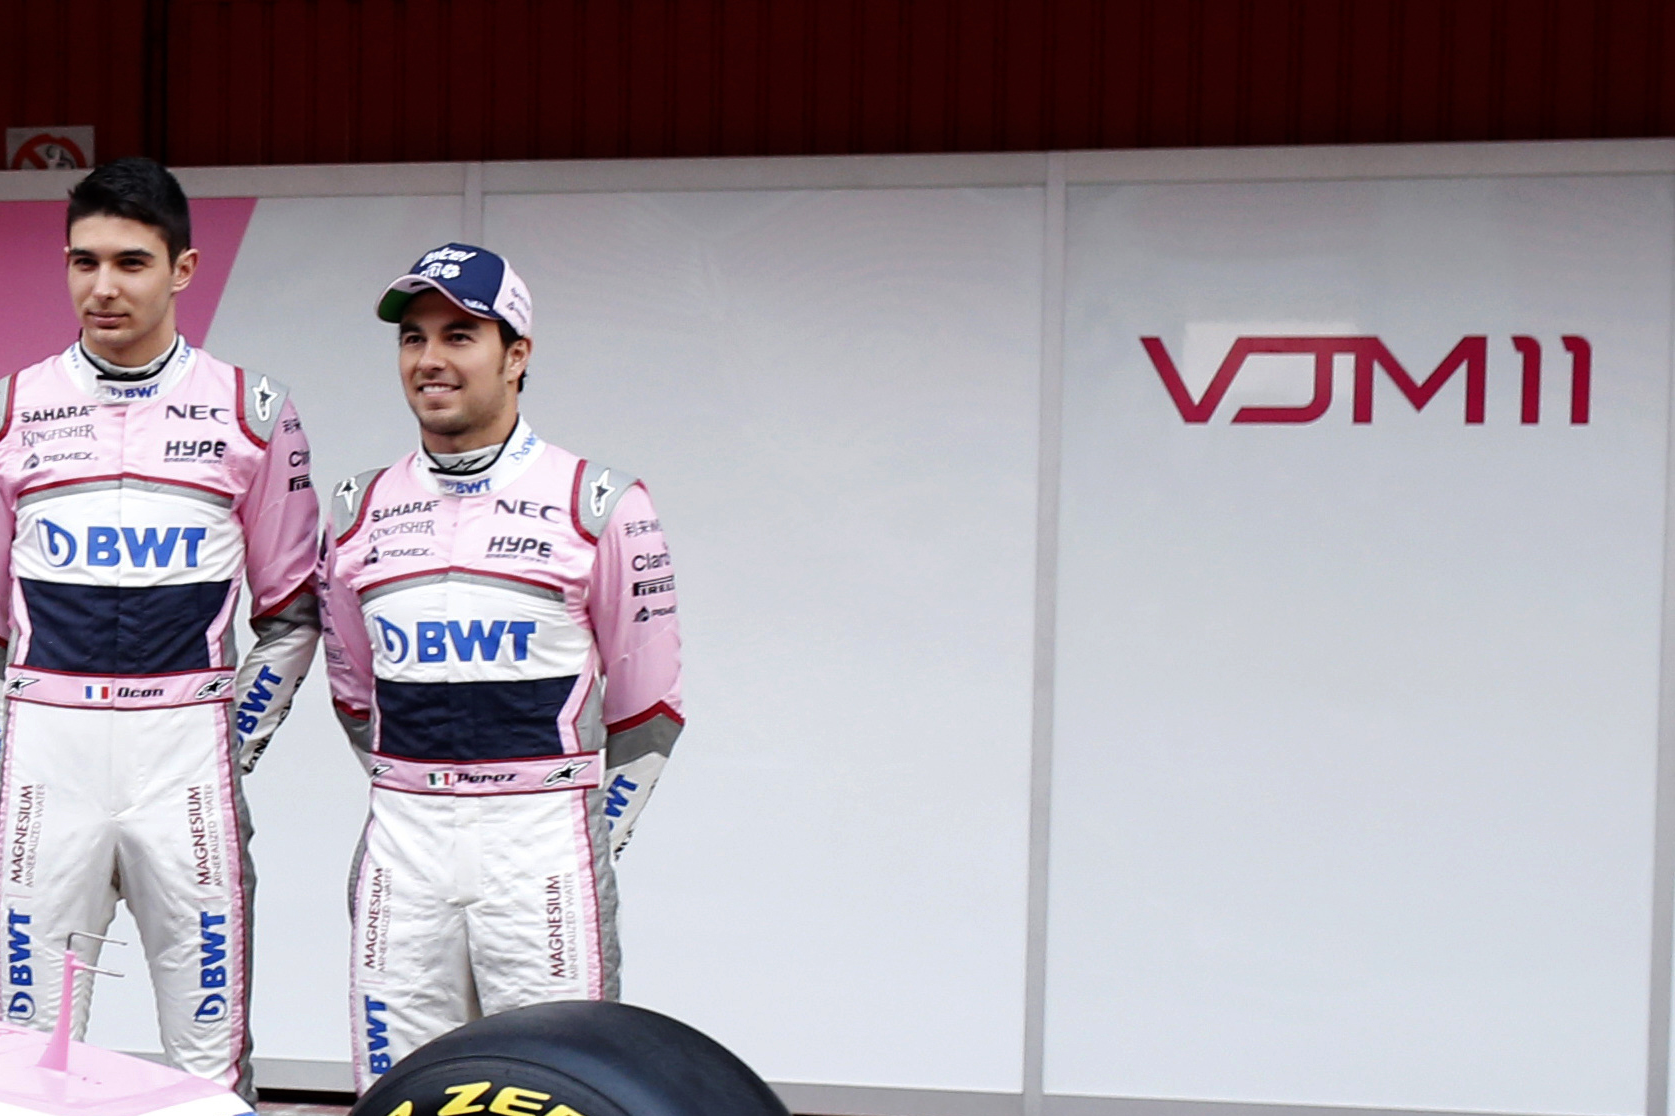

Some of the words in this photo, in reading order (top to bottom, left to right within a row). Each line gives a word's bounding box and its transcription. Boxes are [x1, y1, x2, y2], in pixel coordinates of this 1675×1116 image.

[125, 383, 160, 399] BWT
[21, 406, 89, 423] SAHARA
[165, 404, 230, 425] NEC
[21, 424, 98, 448] KINGFISHER
[42, 452, 93, 462] PEMEX
[164, 440, 227, 458] HYPE
[455, 478, 491, 494] BWT
[368, 520, 435, 544] KINGFISHER
[371, 502, 431, 522] SAHARA
[494, 499, 561, 524] NEC
[86, 526, 207, 568] BWT
[381, 547, 430, 559] PEMEX
[487, 535, 554, 559] HYPE
[416, 620, 536, 663] BWT
[237, 664, 283, 735] BWT
[33, 783, 45, 818] WATER
[203, 783, 215, 818] WATER
[604, 774, 638, 832] WT
[11, 784, 34, 884] MAGNESIUM
[25, 819, 42, 888] MINERALIZED
[187, 785, 211, 885] MAGNESIUM
[206, 820, 224, 887] MINERALIZED
[364, 868, 384, 969] MAGNESIUM
[378, 905, 393, 973] MINERALIZED
[544, 874, 565, 978] MAGNESIUM
[9, 907, 34, 987] BWT
[200, 911, 227, 988] BWT
[566, 908, 580, 980] MINERALIZED
[365, 995, 392, 1075] BWT
